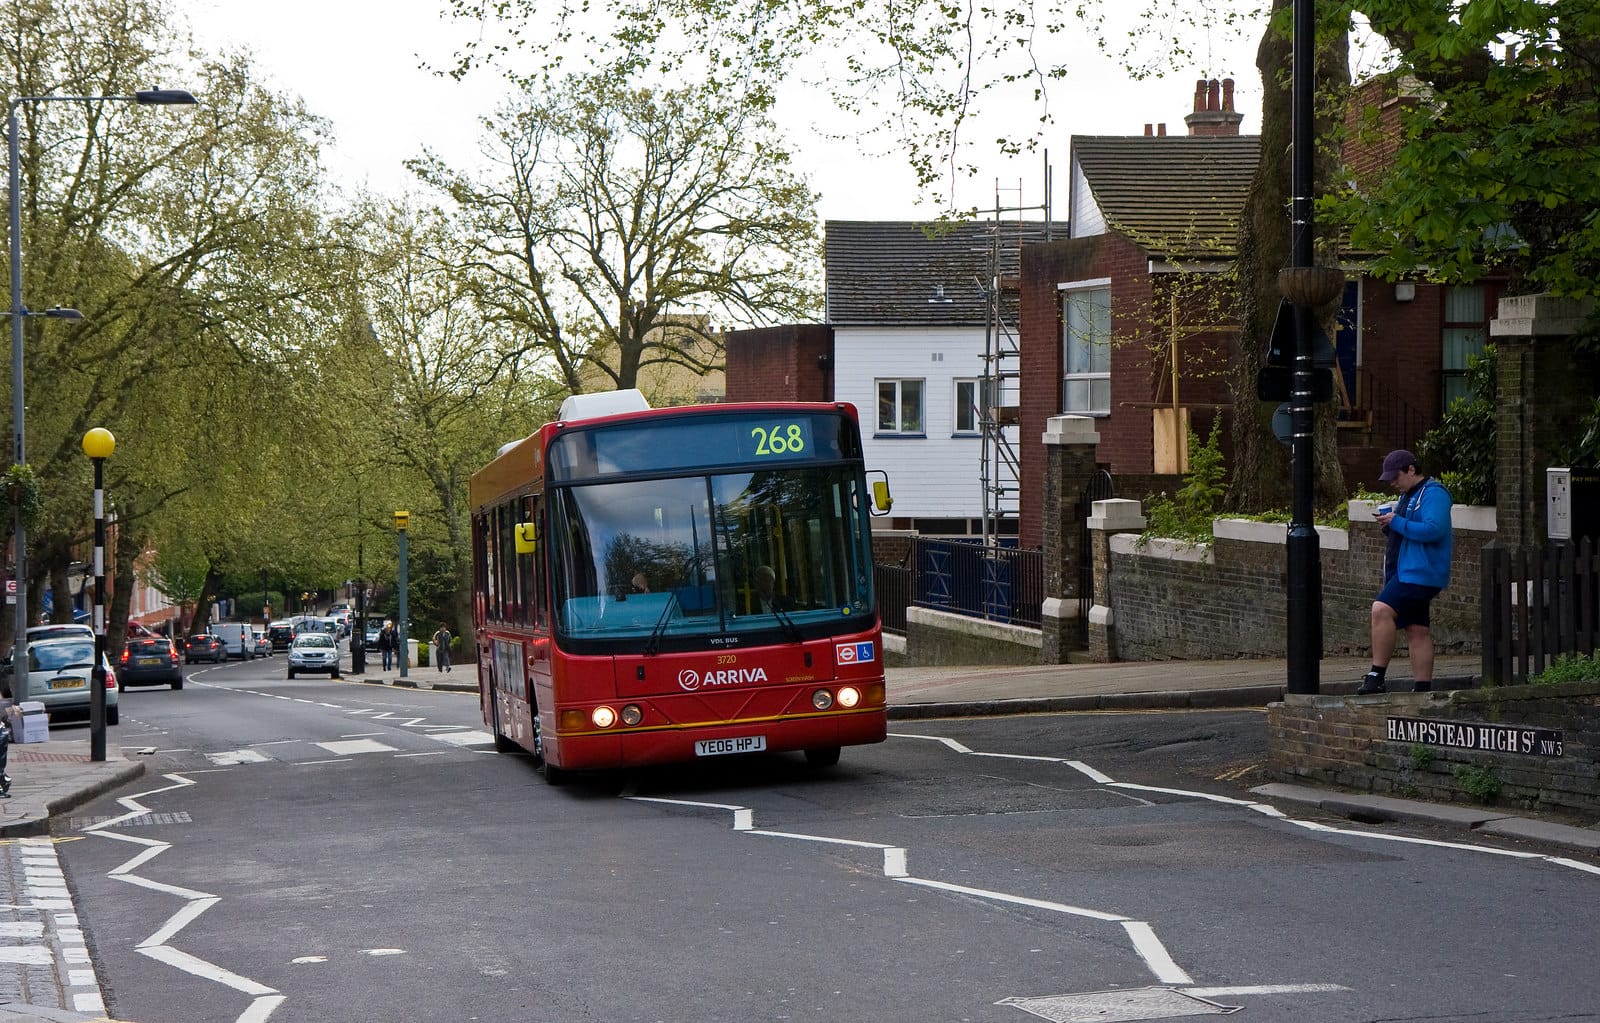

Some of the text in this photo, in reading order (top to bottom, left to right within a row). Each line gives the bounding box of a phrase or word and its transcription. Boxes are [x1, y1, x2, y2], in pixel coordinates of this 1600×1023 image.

[751, 424, 804, 455] 268
[717, 655, 736, 664] 3720
[703, 667, 768, 685] ARRIVA
[1387, 719, 1475, 748] HAMPSTEAD
[1479, 728, 1518, 752] HIGH
[700, 737, 761, 753] YE06 HPJ
